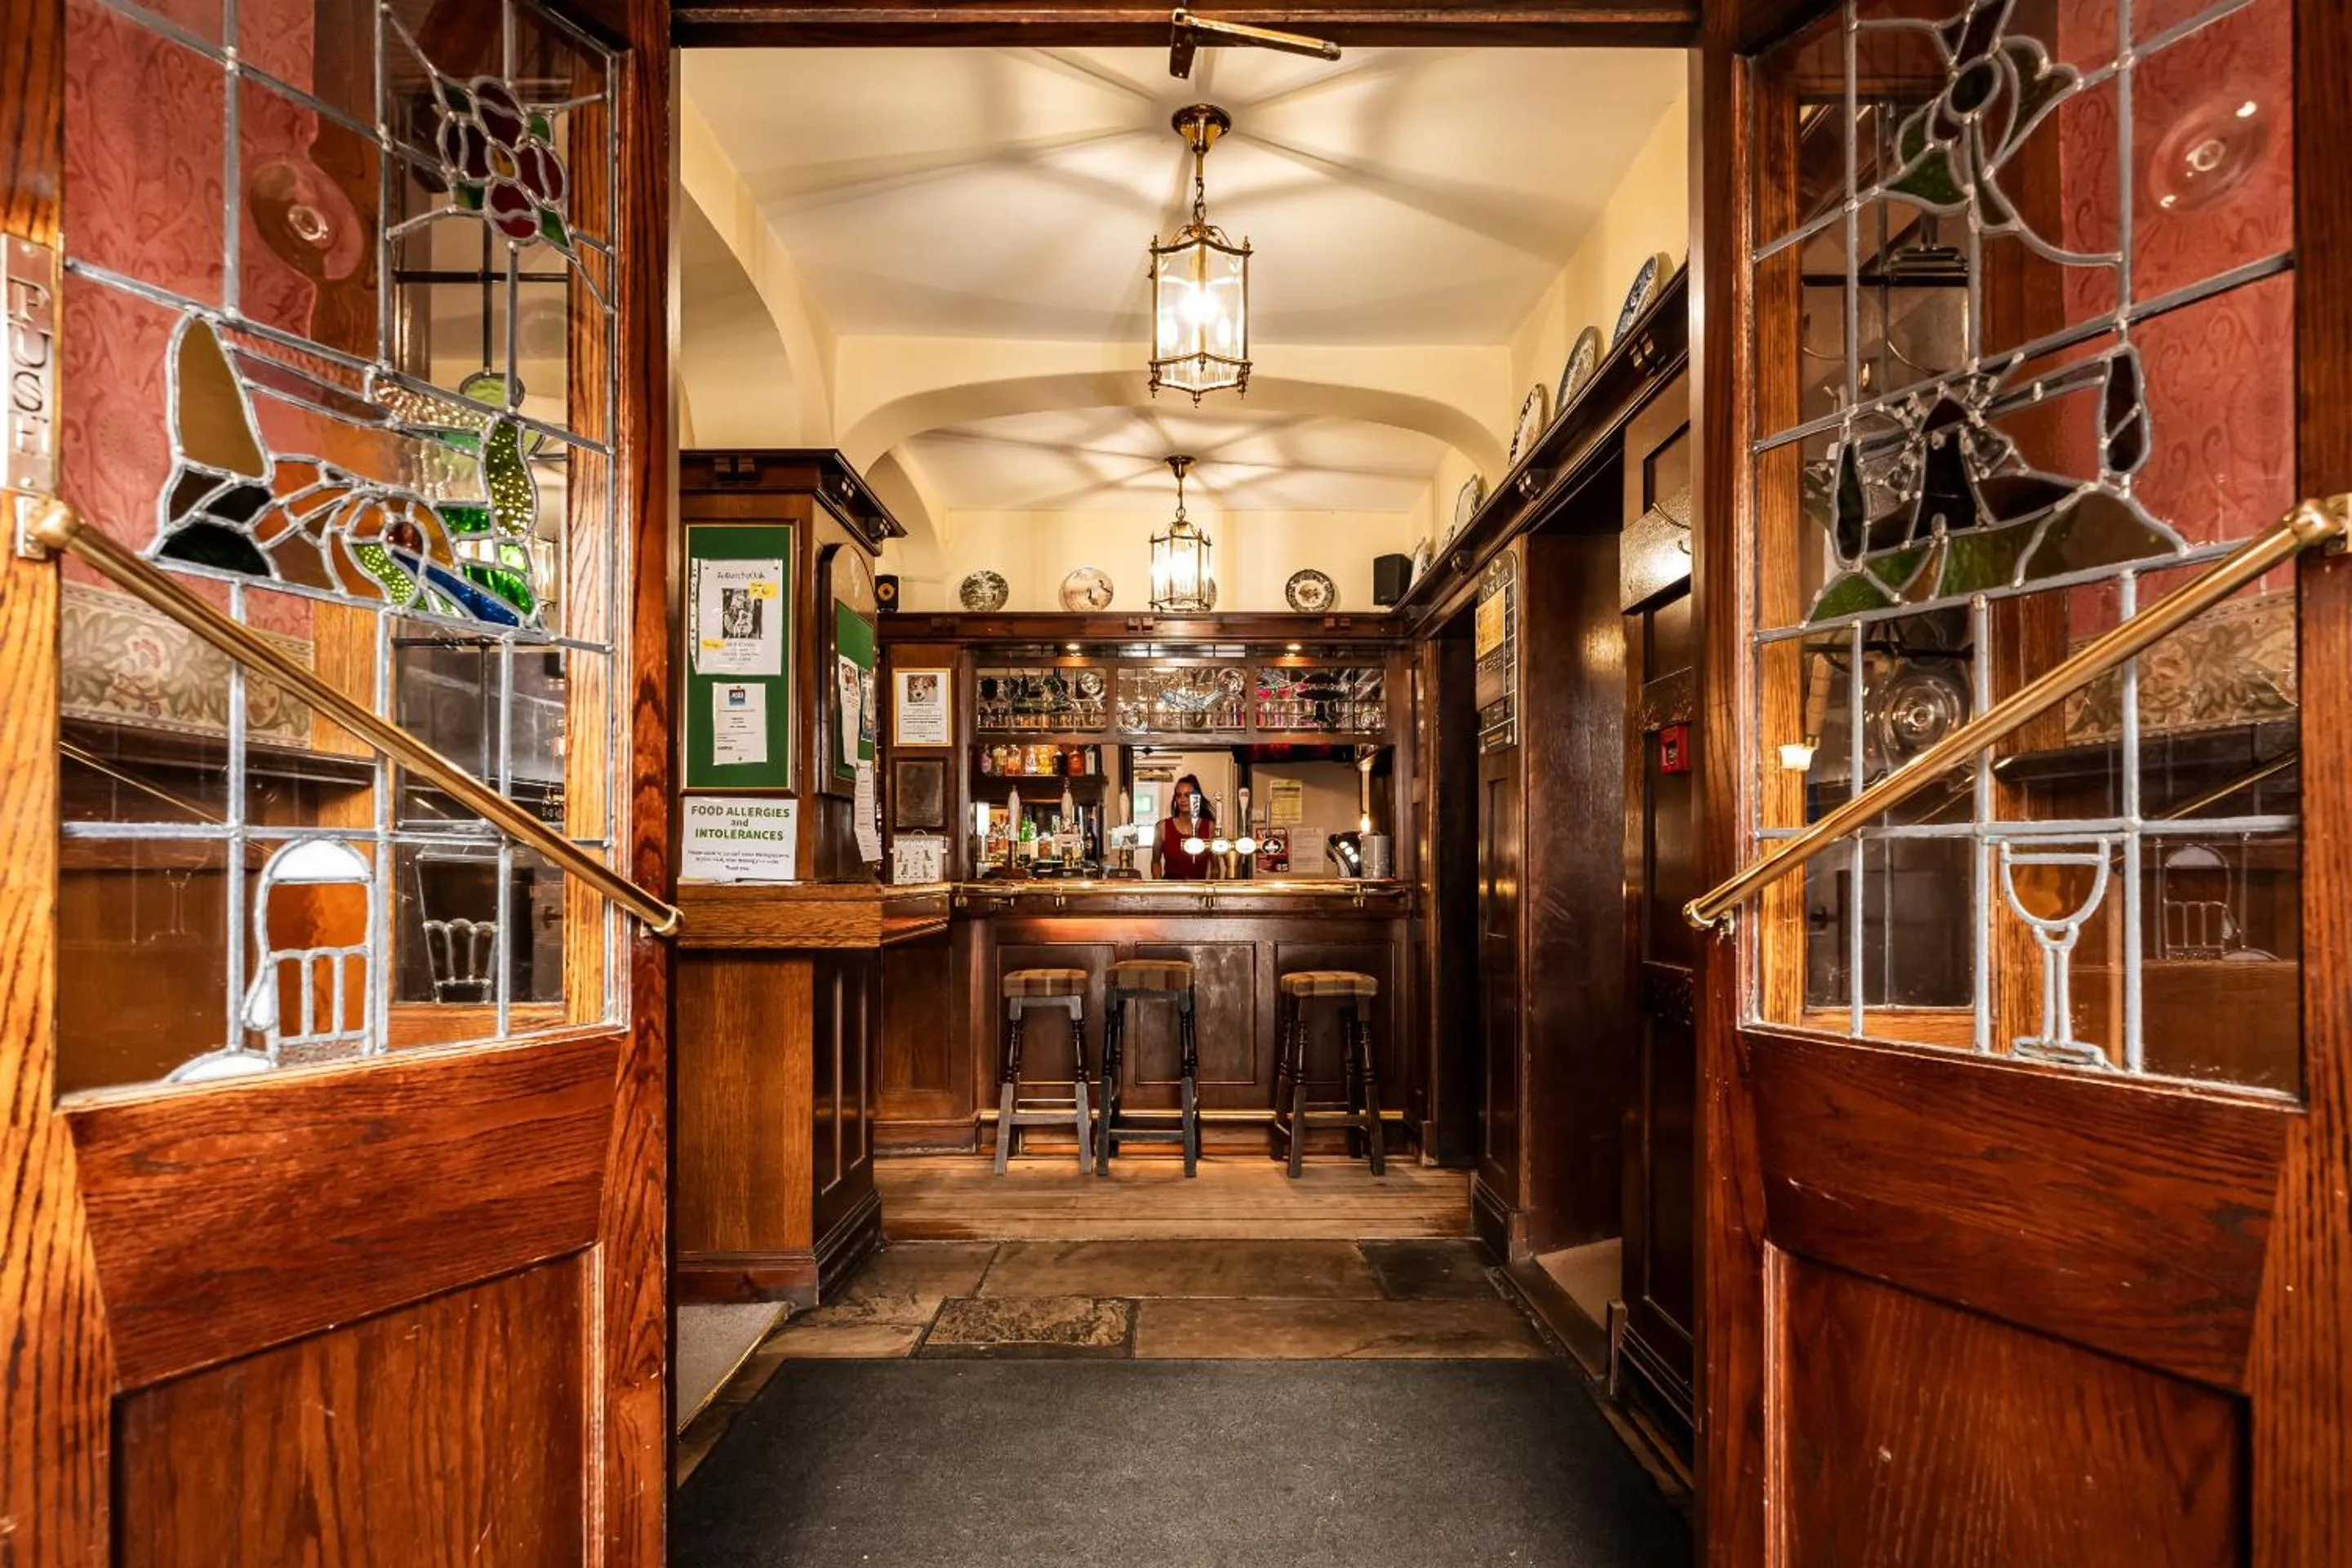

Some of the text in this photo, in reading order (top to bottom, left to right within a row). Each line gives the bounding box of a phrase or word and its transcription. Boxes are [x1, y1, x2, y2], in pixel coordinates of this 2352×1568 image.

[7, 276, 51, 455] PUSH
[691, 805, 790, 818] FOOD ALLERGIES
[730, 818, 749, 827] and
[695, 828, 784, 841] INTOLERANCES
